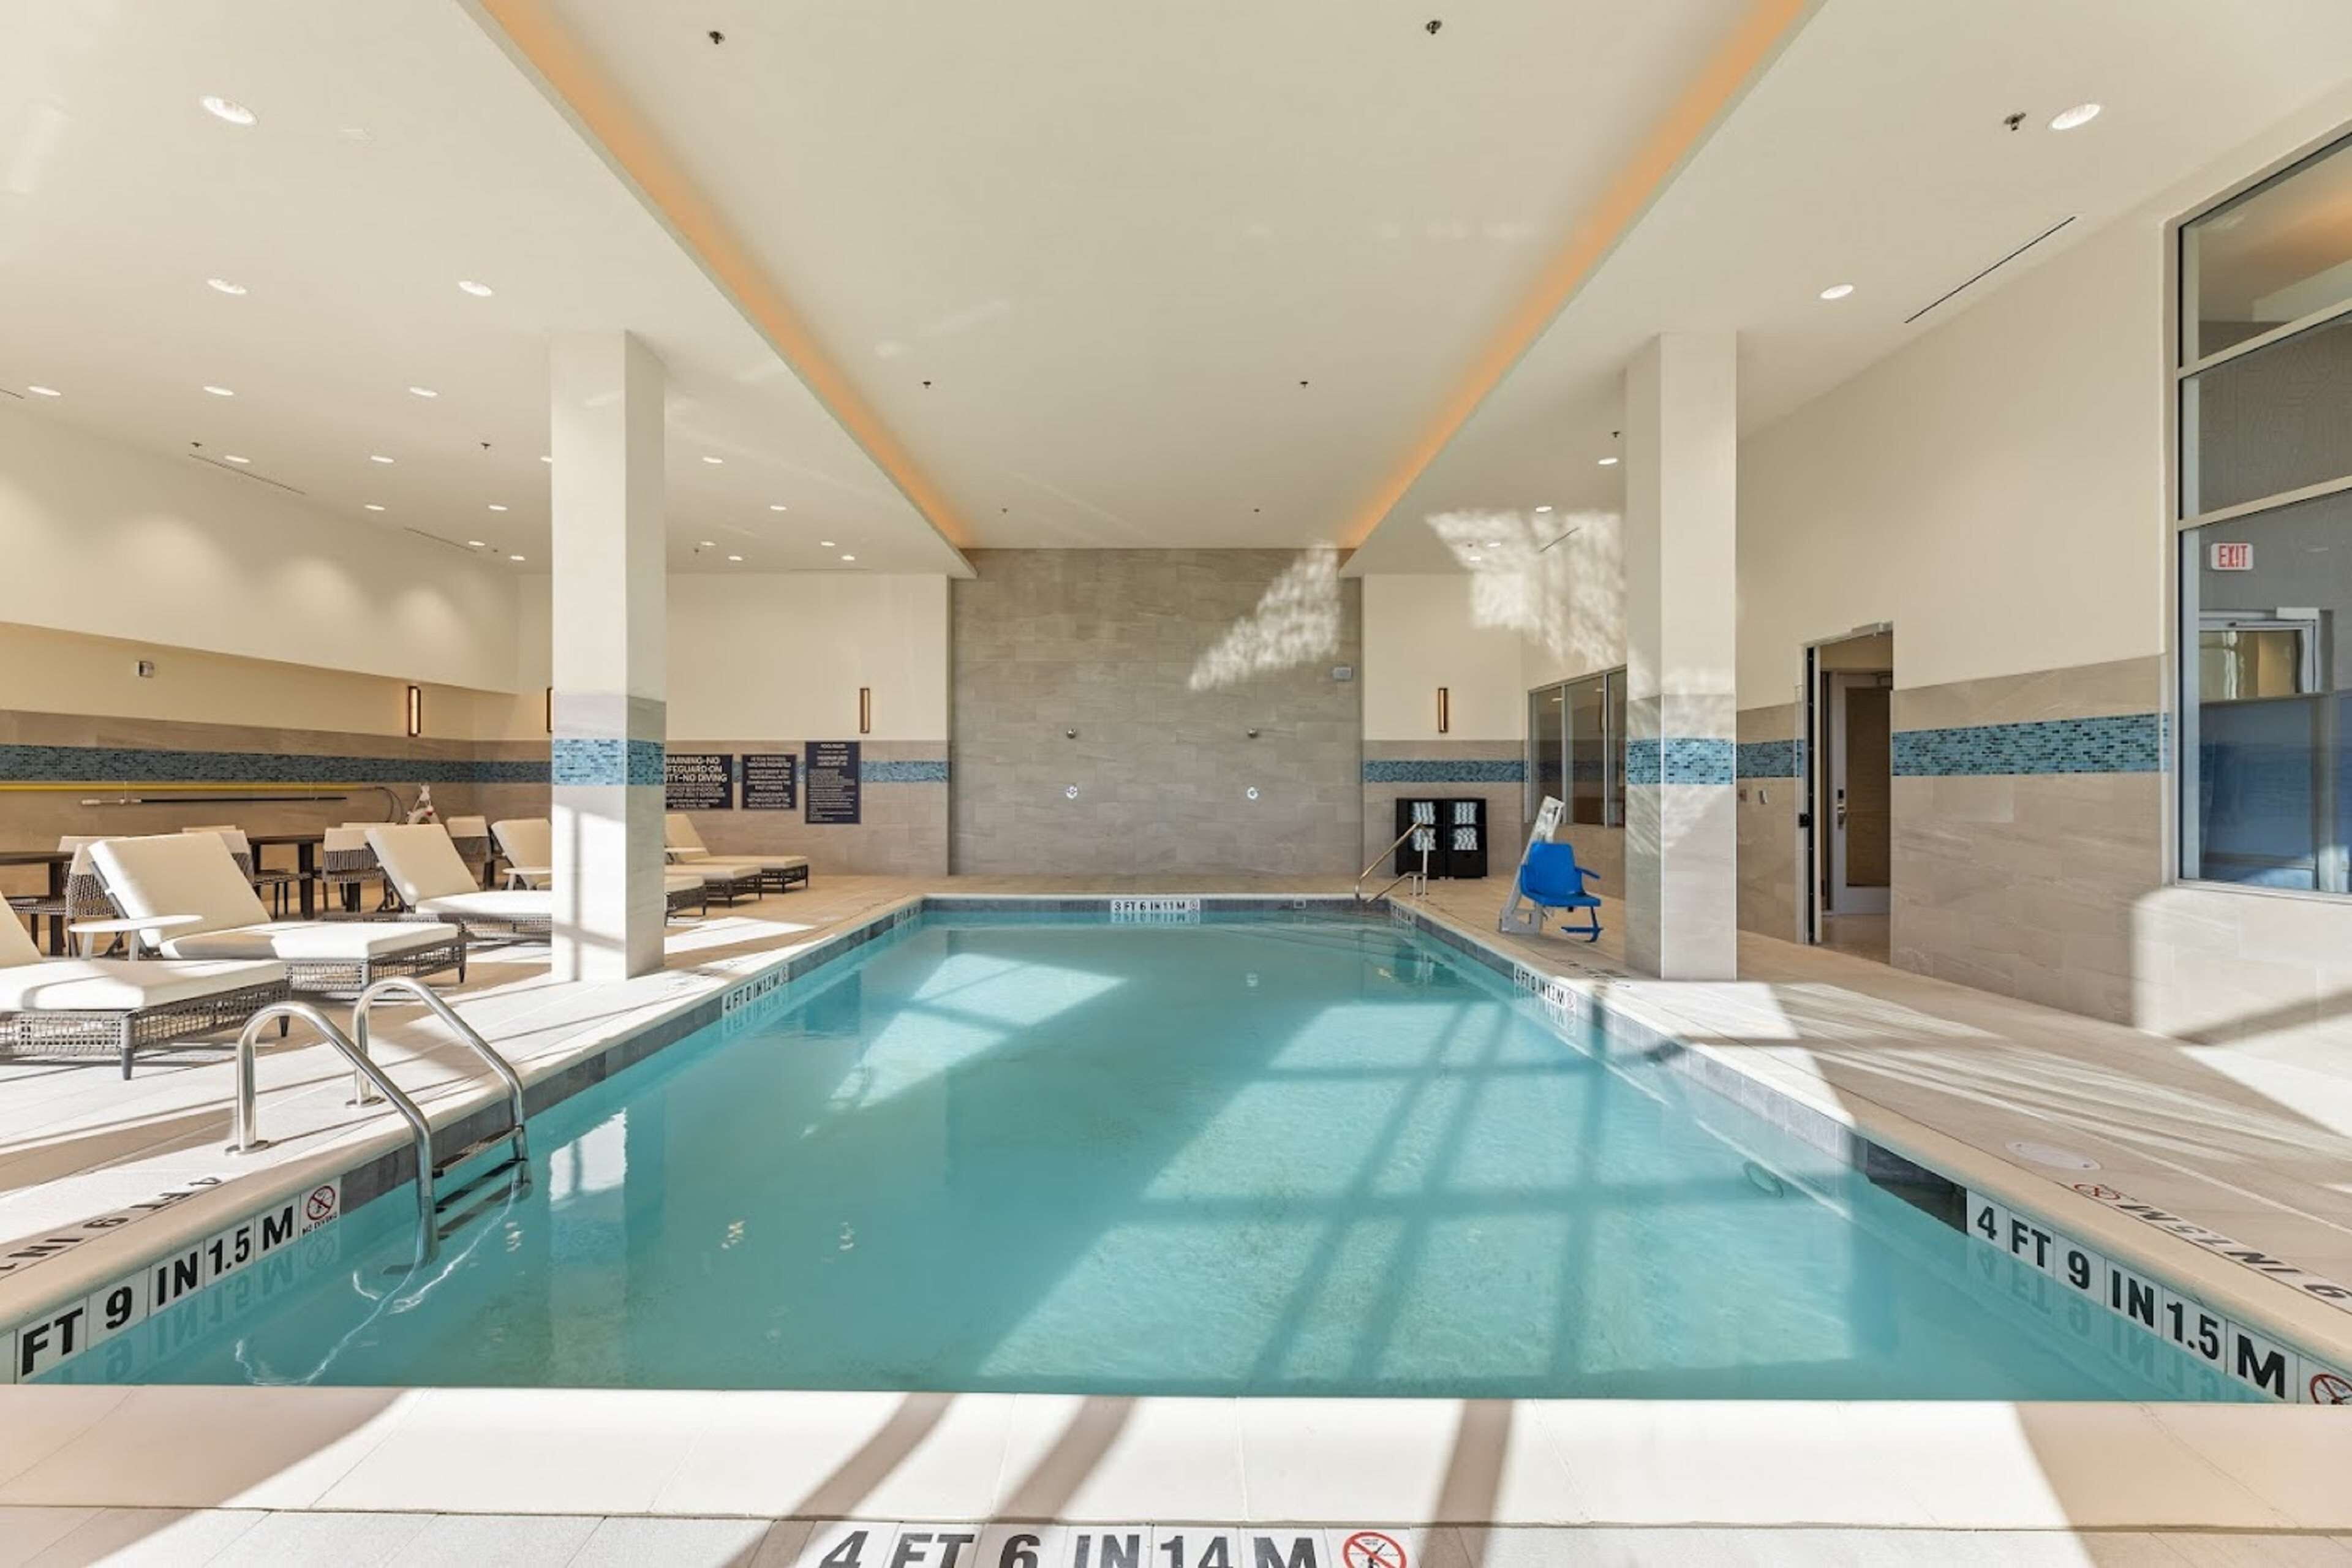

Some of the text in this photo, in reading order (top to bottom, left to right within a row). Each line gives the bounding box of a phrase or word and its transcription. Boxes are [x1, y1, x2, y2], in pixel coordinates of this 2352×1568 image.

[2218, 545, 2247, 568] EXIT
[698, 774, 728, 783] DIVING
[1115, 901, 1121, 911] 3
[1123, 901, 1136, 911] FT
[1140, 901, 1146, 911] 6
[1150, 901, 1160, 911] IN
[1177, 901, 1185, 911] M
[725, 995, 731, 1010] 4
[733, 989, 743, 1009] FT
[753, 980, 763, 998] IN
[772, 971, 780, 987] M
[1521, 970, 1529, 988] FT
[1538, 979, 1545, 995] IN
[1558, 989, 1565, 1006] M
[2116, 1204, 2182, 1222] M
[2224, 1251, 2302, 1273] IN
[21, 1205, 293, 1377] FT 9 IN 1.5 M
[1977, 1206, 2286, 1400] 4 FT 9 IN 1.5 M
[818, 1531, 869, 1568] 4
[891, 1532, 975, 1568] FT
[998, 1534, 1041, 1568] 6
[1074, 1534, 1140, 1568] IN
[1253, 1537, 1317, 1568] M
